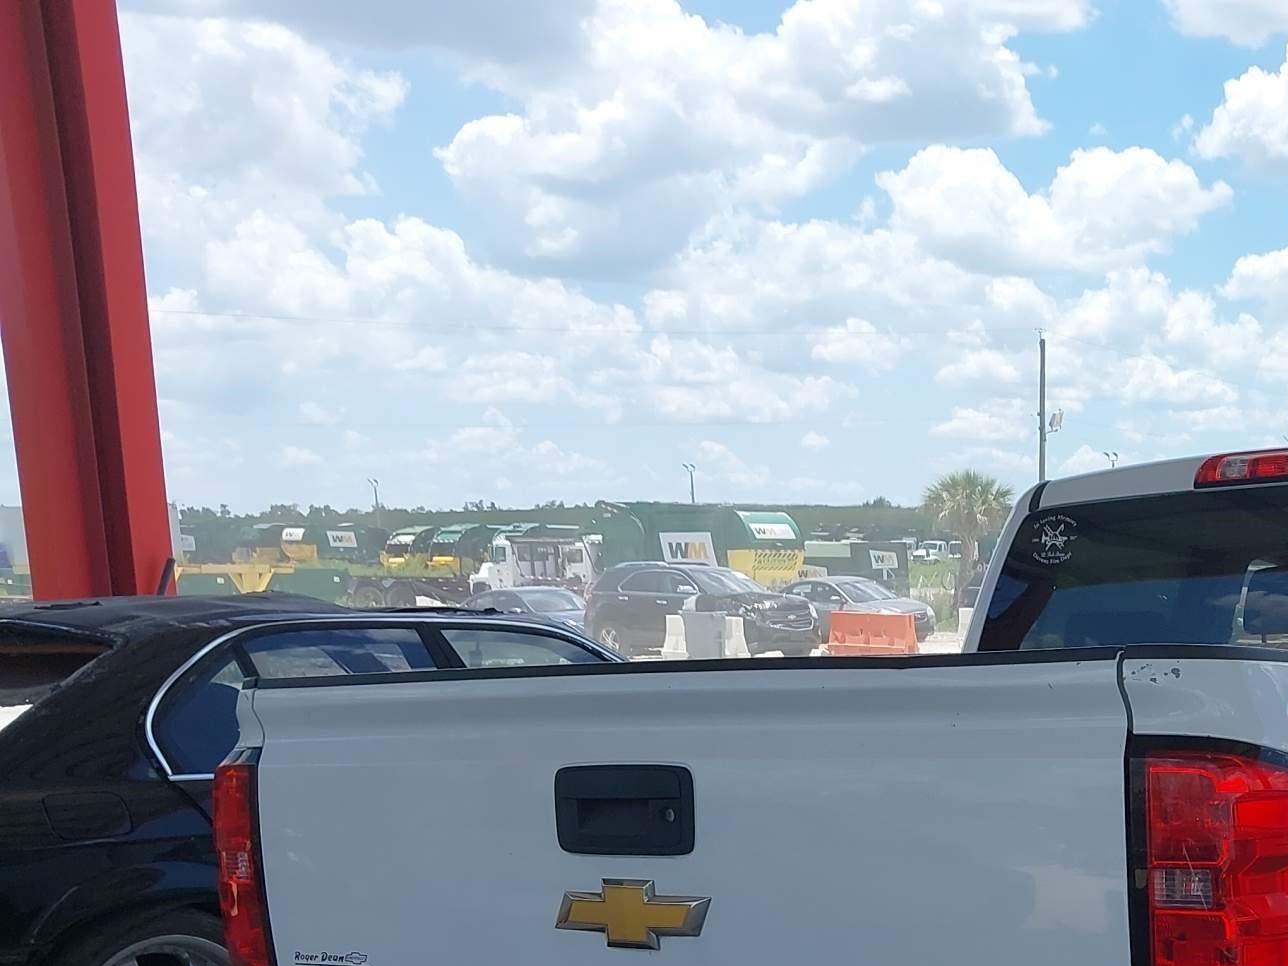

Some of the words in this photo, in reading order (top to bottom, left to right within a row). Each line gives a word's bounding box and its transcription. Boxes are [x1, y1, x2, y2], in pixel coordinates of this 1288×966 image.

[667, 541, 709, 560] WM
[294, 951, 319, 963] Roger
[320, 951, 345, 963] Dean
